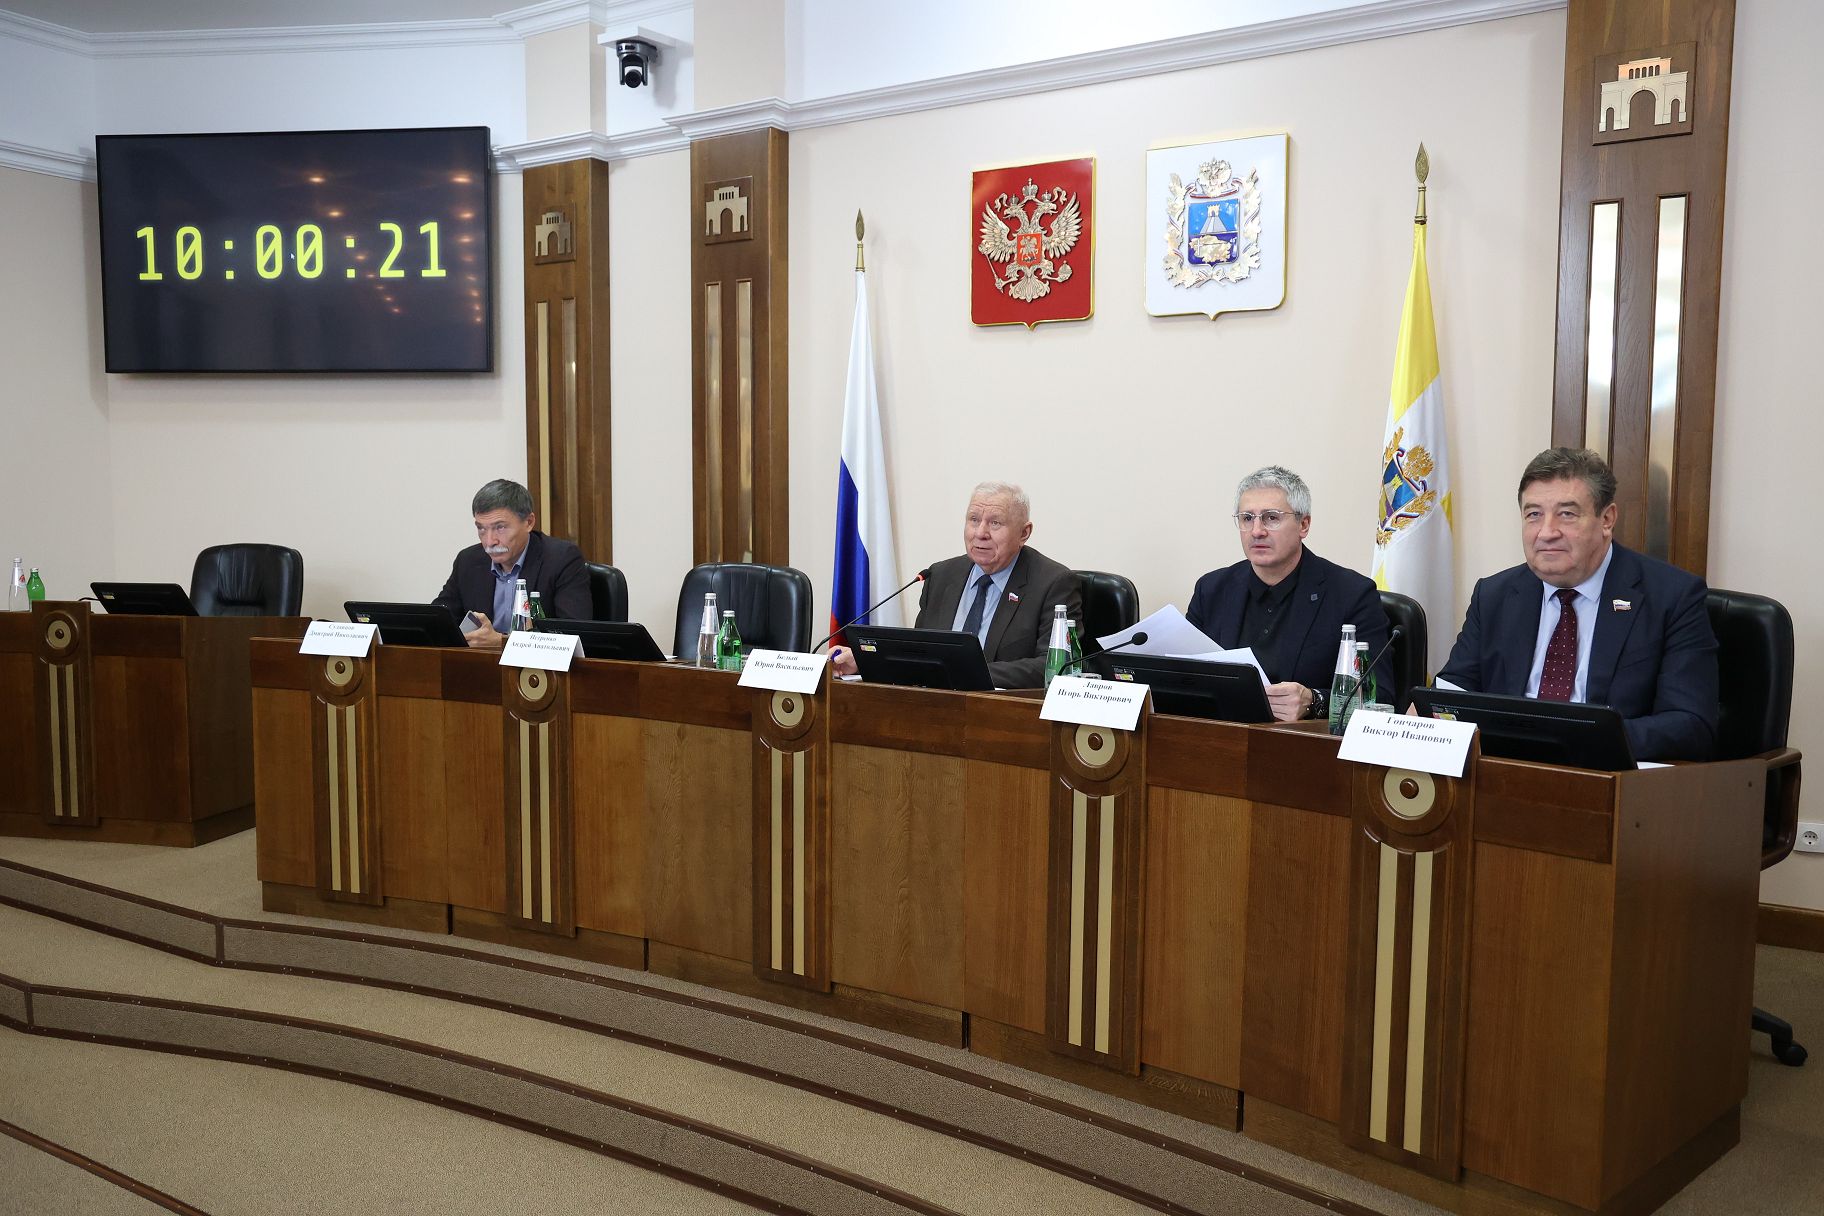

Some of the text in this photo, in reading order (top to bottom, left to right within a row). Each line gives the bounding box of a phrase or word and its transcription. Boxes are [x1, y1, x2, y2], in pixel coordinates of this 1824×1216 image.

[136, 222, 447, 281] 10:00:21
[754, 661, 814, 672] Юрий Васильевич
[1082, 681, 1113, 691] Лавров
[1057, 688, 1132, 704] Игорь Викторович
[1386, 716, 1435, 730] Гончаров
[1362, 725, 1453, 745] Виктор Иванович
